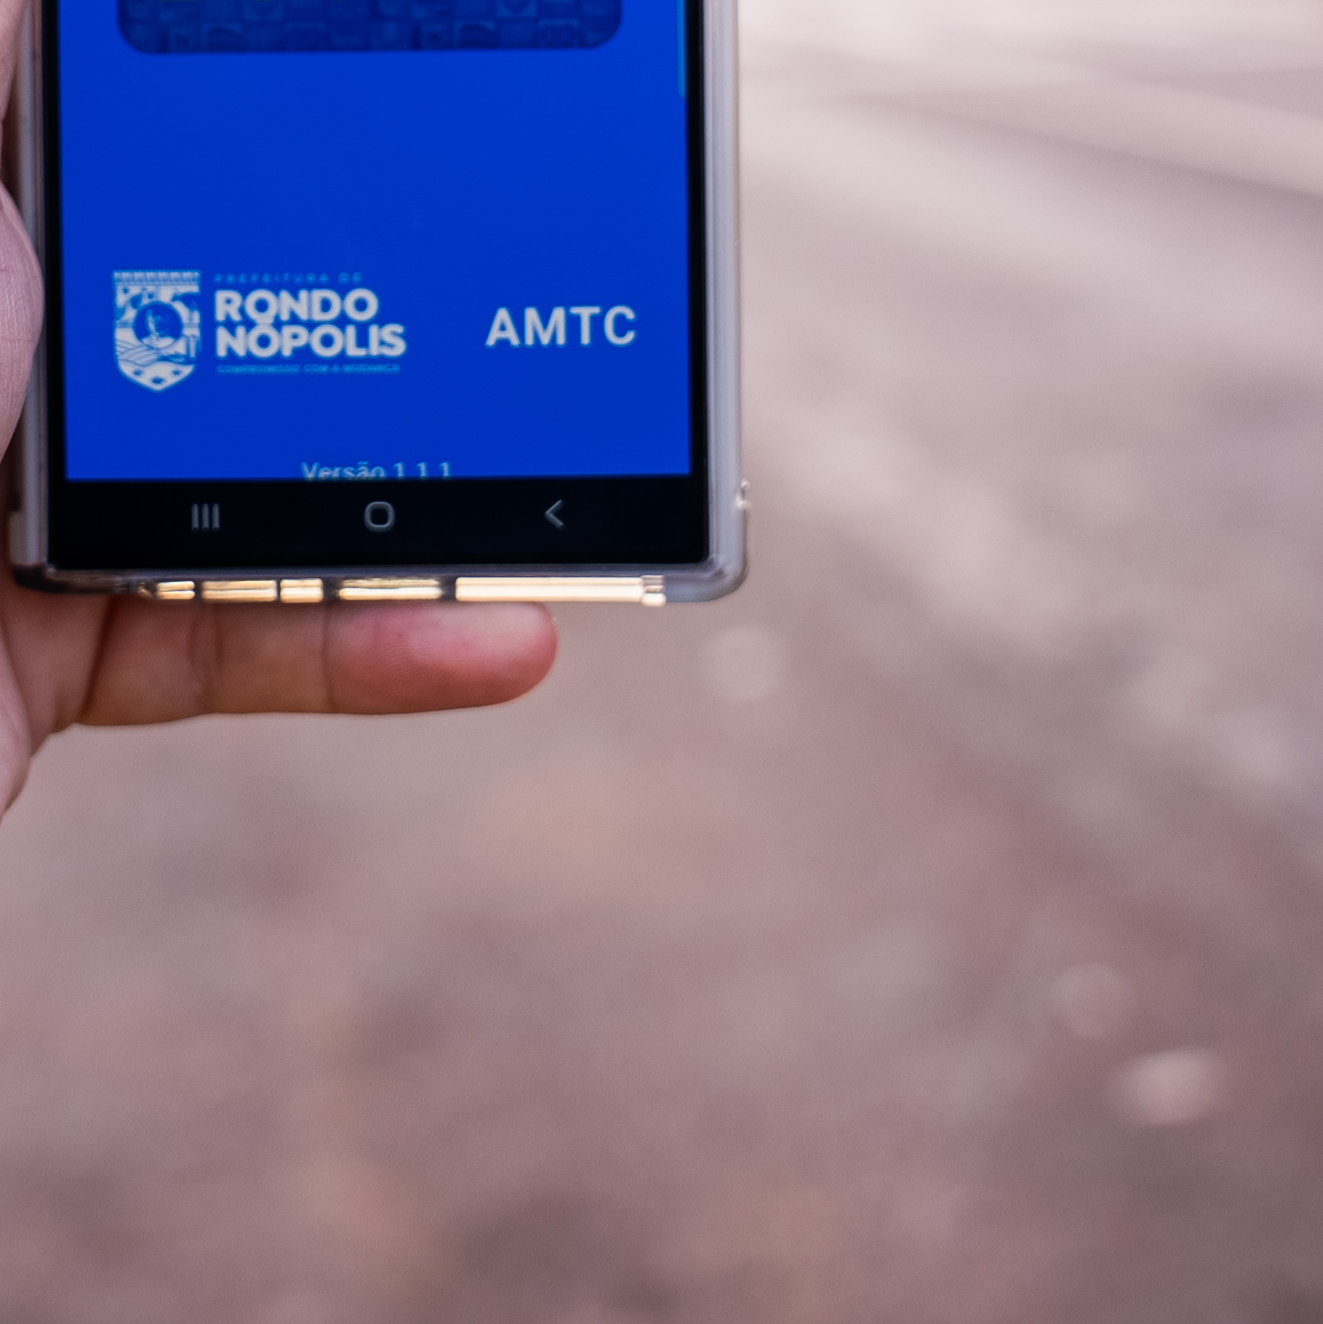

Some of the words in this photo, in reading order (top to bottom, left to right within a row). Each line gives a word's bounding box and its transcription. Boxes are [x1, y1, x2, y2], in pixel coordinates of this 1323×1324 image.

[214, 287, 379, 322] RONDO
[485, 304, 637, 348] AMTC
[300, 460, 387, 481] Versão
